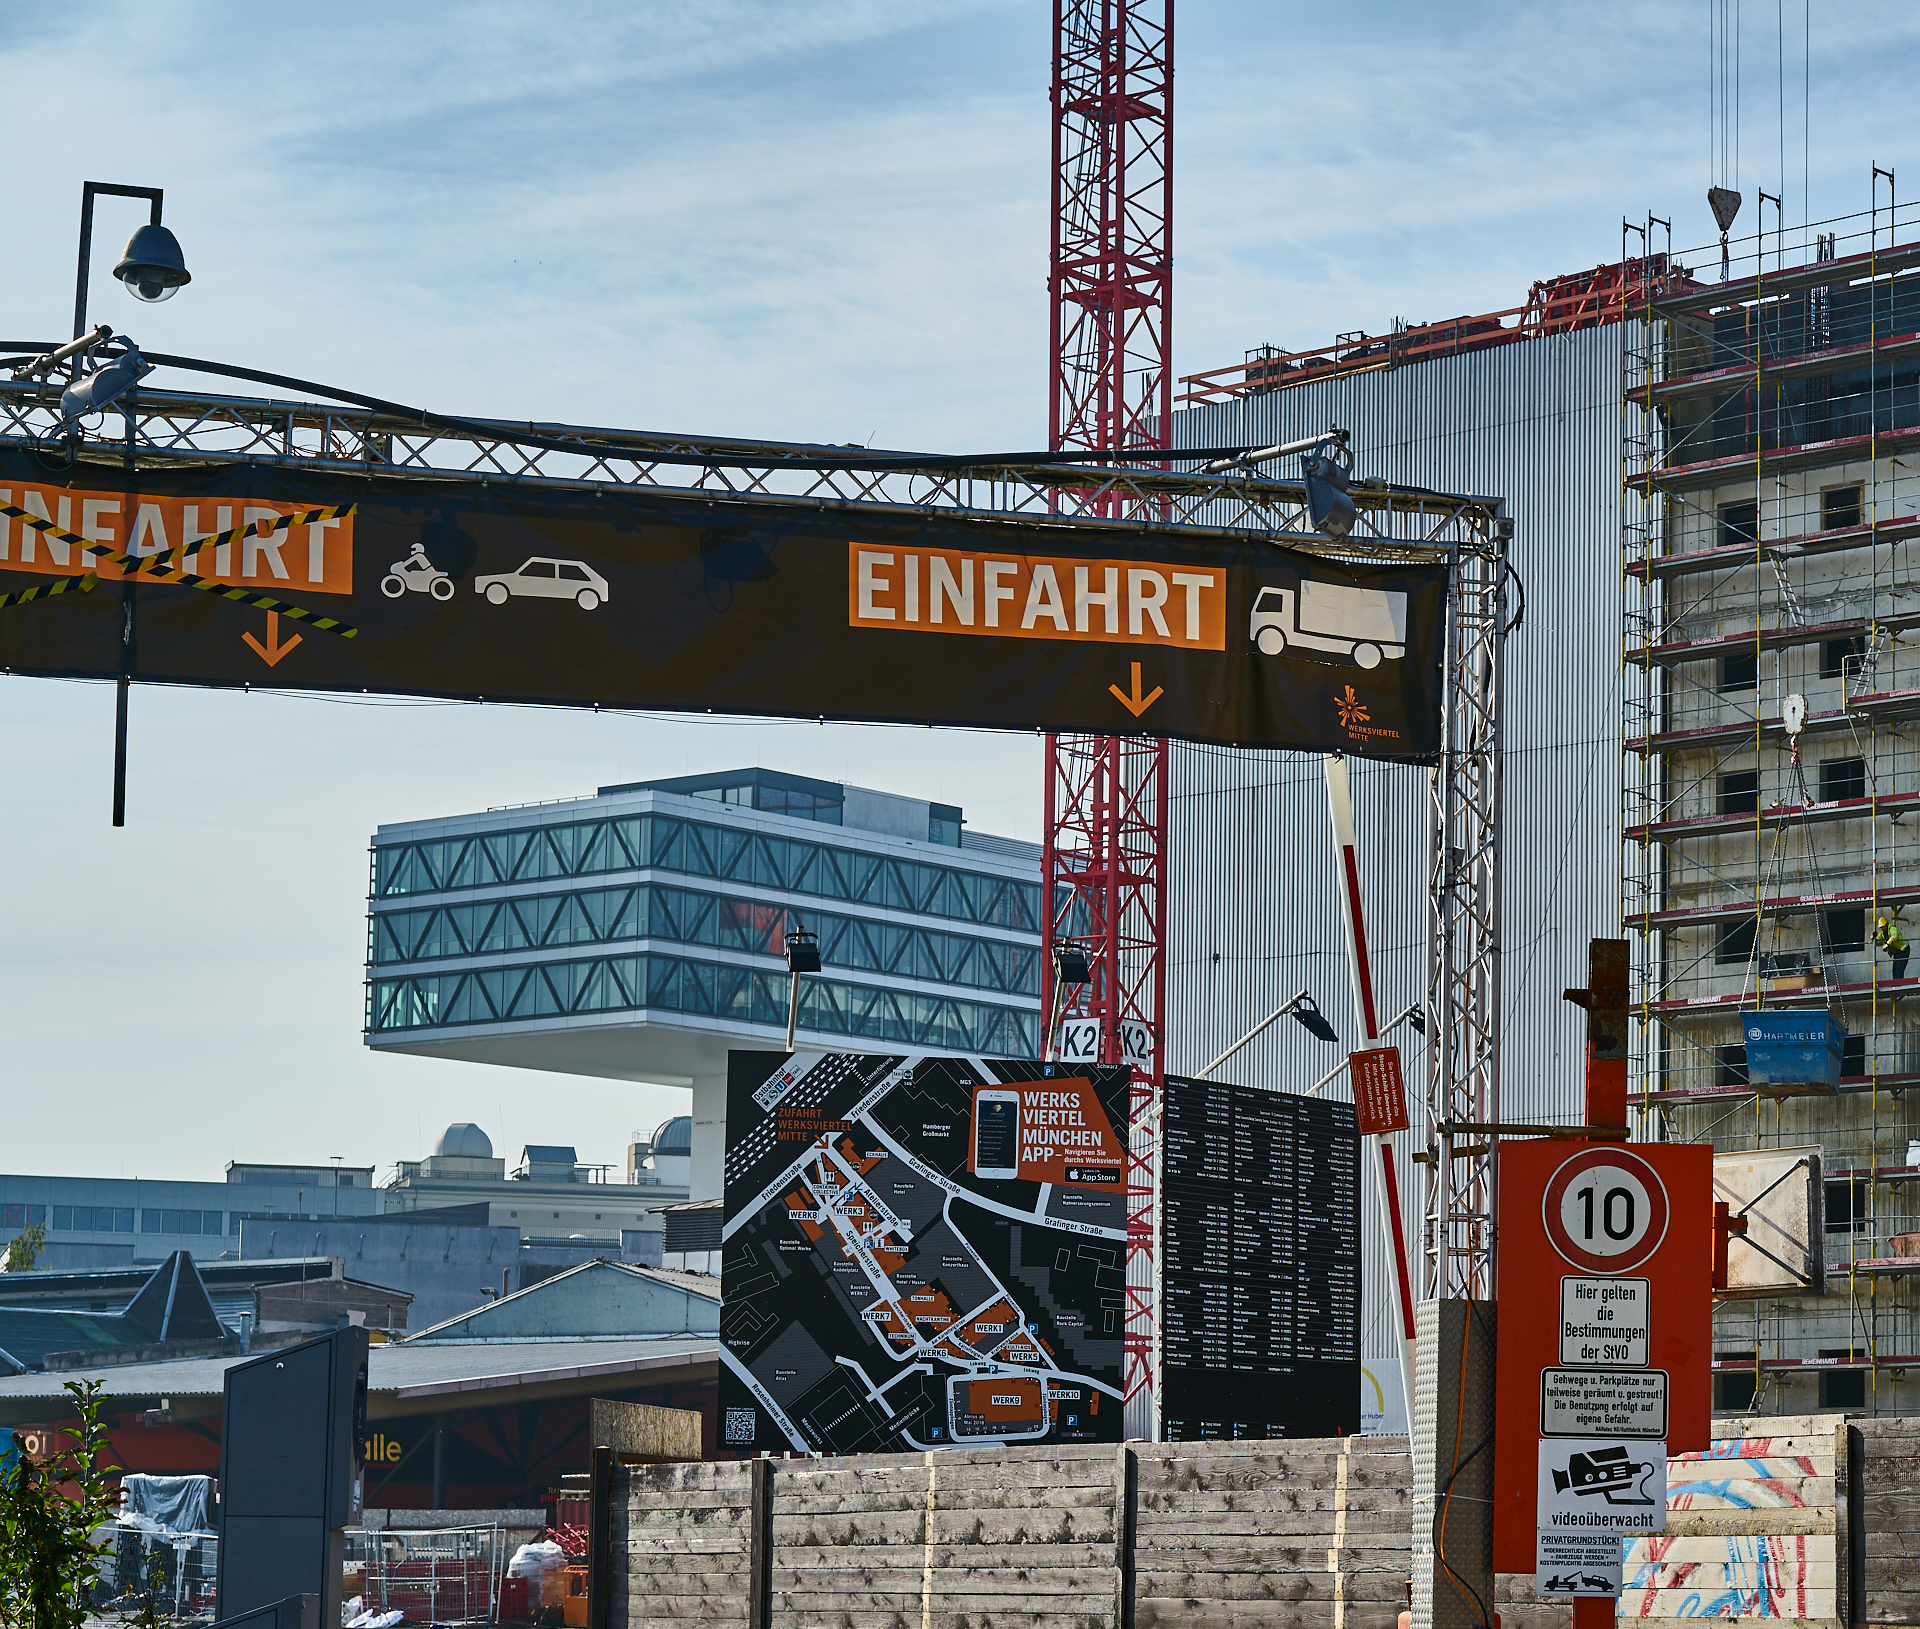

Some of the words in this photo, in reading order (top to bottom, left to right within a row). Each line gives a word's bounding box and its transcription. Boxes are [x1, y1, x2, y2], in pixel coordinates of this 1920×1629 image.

[858, 551, 1214, 641] EINFAHRT
[1348, 724, 1400, 738] WERKSVIERTEL
[1348, 732, 1368, 742] MITTE
[1063, 1025, 1096, 1057] K2
[1121, 1025, 1147, 1059] K2
[1763, 1032, 1825, 1040] HARTMEIER
[865, 1057, 894, 1081] Unterführung
[1379, 1053, 1389, 1092] Stopp-Schild
[753, 1067, 787, 1101] Ostbahnhof
[850, 1081, 892, 1119] Friedenstraße
[1024, 1091, 1080, 1108] WERKS
[778, 1108, 822, 1118] ZUFAHRT
[1023, 1109, 1086, 1127] VIERTEL
[778, 1119, 852, 1131] WERKSVIERTEL
[778, 1131, 808, 1141] MITTE
[1022, 1127, 1102, 1147] MÜNCHEN
[1021, 1147, 1054, 1163] APP
[1064, 1149, 1095, 1157] Navigieren
[1096, 1149, 1107, 1157] Sie
[1064, 1156, 1084, 1164] durchs
[1085, 1157, 1122, 1165] Werksviertel
[761, 1162, 803, 1201] Friedenstraße
[908, 1157, 939, 1182] Grafinger
[938, 1178, 961, 1194] Straße
[1081, 1173, 1096, 1181] App
[790, 1211, 818, 1219] WERK8
[836, 1207, 863, 1215] WERK3
[863, 1189, 899, 1227] Atelierstraße
[1577, 1187, 1635, 1241] 10
[1044, 1217, 1078, 1231] Grafinger
[1079, 1224, 1103, 1236] Straße
[845, 1230, 881, 1280] Speicherstraße
[1575, 1284, 1598, 1300] Hier
[1601, 1286, 1636, 1304] gelten
[863, 1312, 890, 1320] WERK7
[892, 1301, 913, 1330] Speicherstraße
[1597, 1306, 1614, 1321] die
[976, 1324, 1002, 1332] WERK1
[1564, 1322, 1646, 1343] Bestimmungen
[727, 1339, 750, 1347] Highrise
[920, 1349, 947, 1357] WERK6
[1011, 1352, 1038, 1360] WERK5
[1581, 1344, 1600, 1359] der
[1603, 1344, 1629, 1361] StVO
[1801, 1357, 1838, 1365] GEMEINHARDT
[1553, 1374, 1589, 1387] Gehwege
[1590, 1377, 1598, 1385] u.
[1599, 1375, 1640, 1388] Parkplätze
[1642, 1378, 1656, 1386] nur
[992, 1396, 1020, 1405] WERK9
[1049, 1390, 1079, 1399] WERK10
[1546, 1387, 1581, 1398] teilweise
[1583, 1388, 1616, 1400] geräumt
[1617, 1391, 1625, 1399] u.
[1626, 1389, 1663, 1400] gestreut!
[751, 1383, 781, 1419] Rosenheimer
[778, 1416, 795, 1438] Straße
[1554, 1400, 1567, 1410] Die
[1569, 1401, 1609, 1412] Benutzung
[1611, 1402, 1639, 1413] erfolgt
[1640, 1401, 1654, 1412] auf
[888, 1406, 921, 1432] Medienbrücke
[1576, 1414, 1602, 1425] eigene
[1604, 1414, 1632, 1424] Gefahr.
[800, 1417, 823, 1445] Mediaworks
[1551, 1511, 1654, 1529] videoüberwacht
[1541, 1535, 1620, 1545] PRIVATGRUNDSTÜCK!
